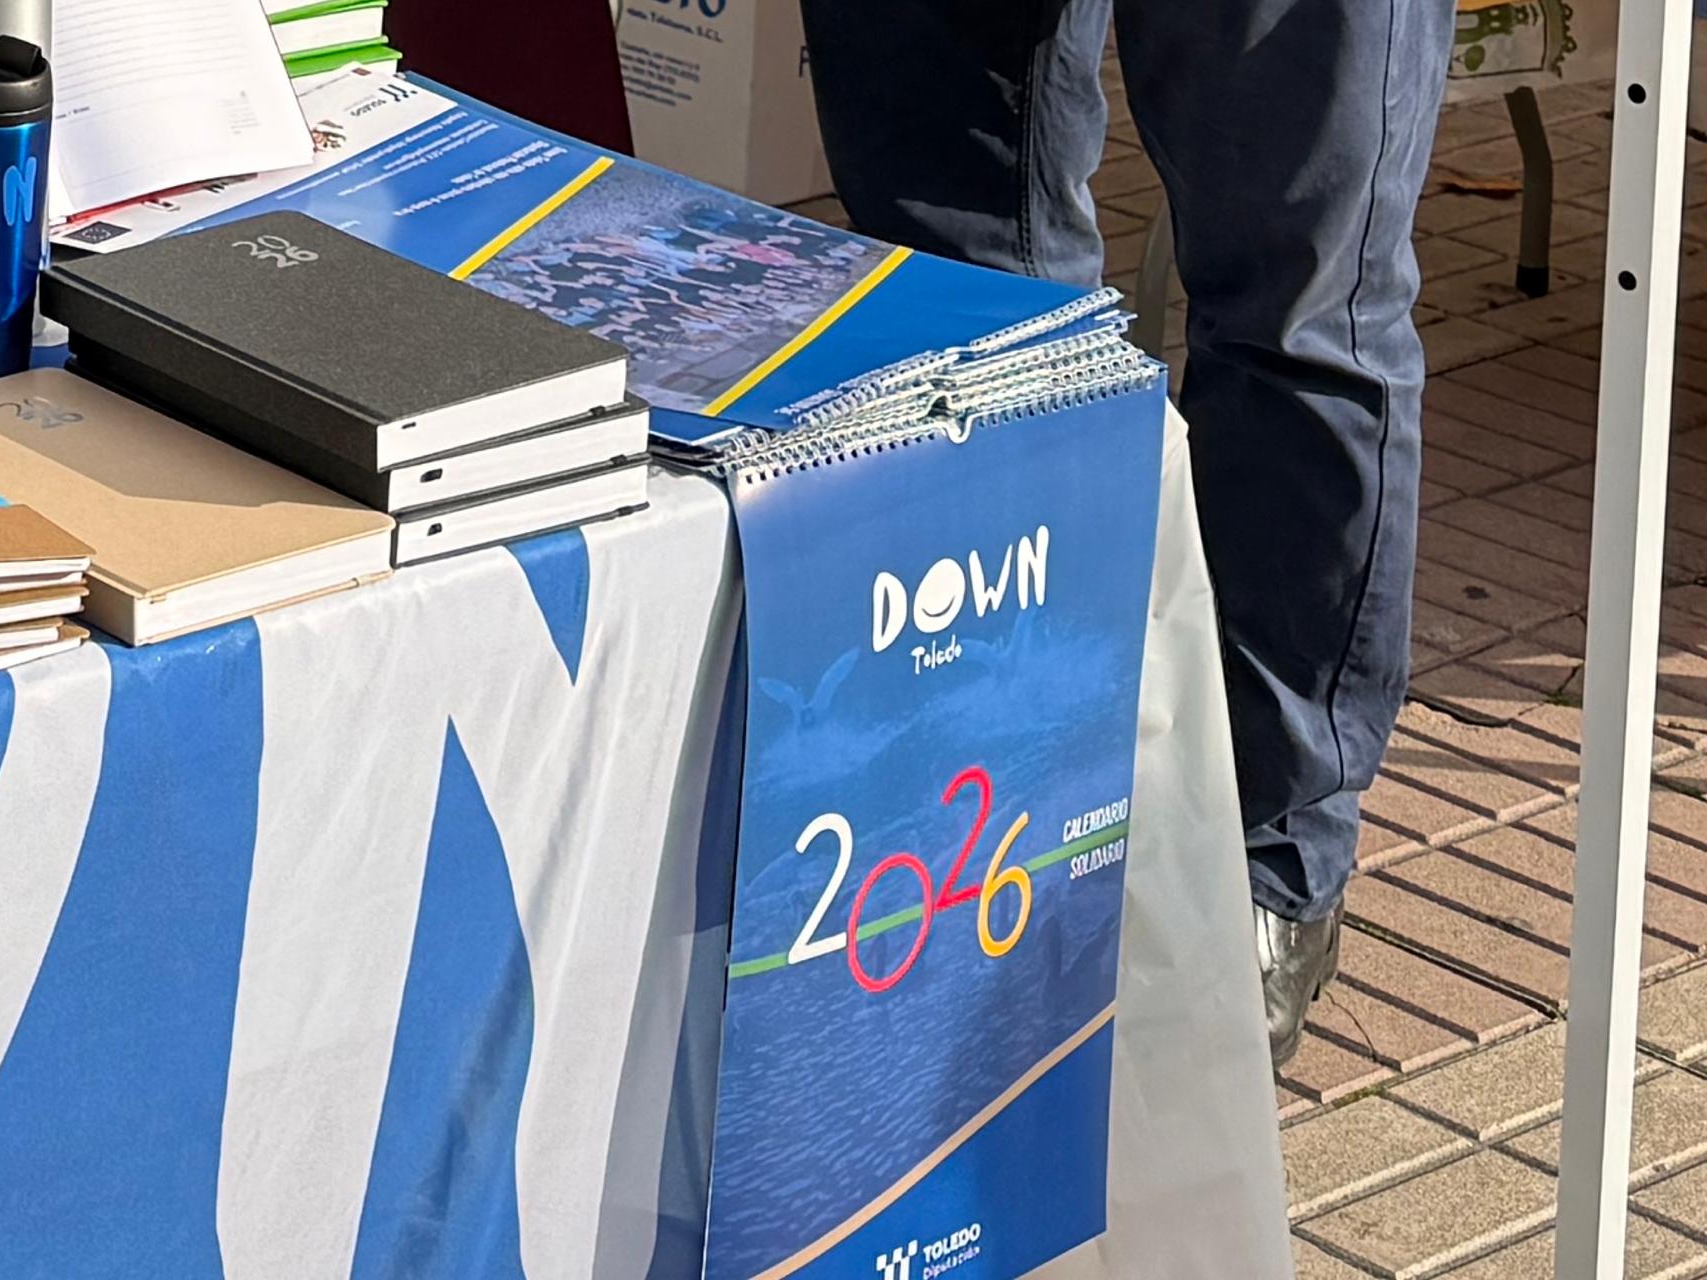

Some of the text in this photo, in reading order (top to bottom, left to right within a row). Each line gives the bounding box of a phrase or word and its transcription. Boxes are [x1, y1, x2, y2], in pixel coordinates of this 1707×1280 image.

[872, 524, 1050, 653] DOWN
[910, 633, 963, 675] Toledo
[1062, 797, 1129, 844] CALENDARIO
[788, 766, 1033, 993] 2026
[922, 1222, 981, 1263] TOLEDO
